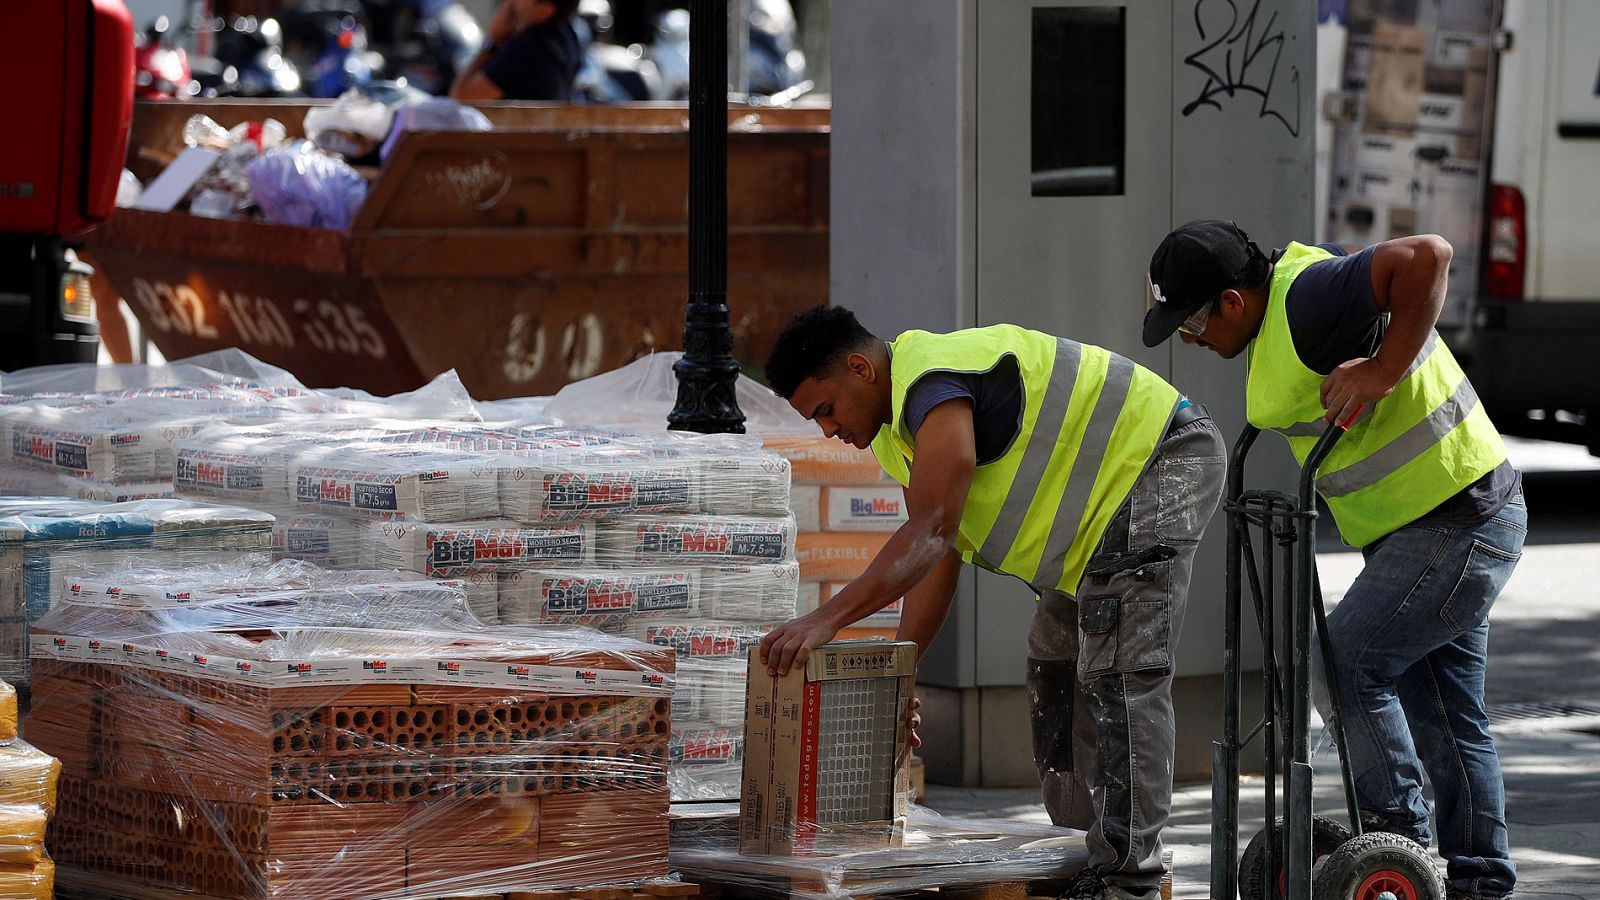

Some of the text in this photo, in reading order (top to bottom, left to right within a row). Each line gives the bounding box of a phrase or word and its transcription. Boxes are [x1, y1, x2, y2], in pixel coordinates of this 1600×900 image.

[297, 475, 351, 503] BigMat
[549, 482, 633, 510] BigMat
[851, 498, 900, 514] BigMat
[530, 539, 560, 547] MORTERO
[643, 531, 728, 556] BigMat
[733, 535, 781, 543] MORTERO SECO
[434, 538, 522, 567] BigMat
[811, 547, 868, 560] FLEXIBLE
[549, 588, 632, 614] BigMat
[363, 661, 387, 669] BigMat
[507, 666, 529, 675] BigMat
